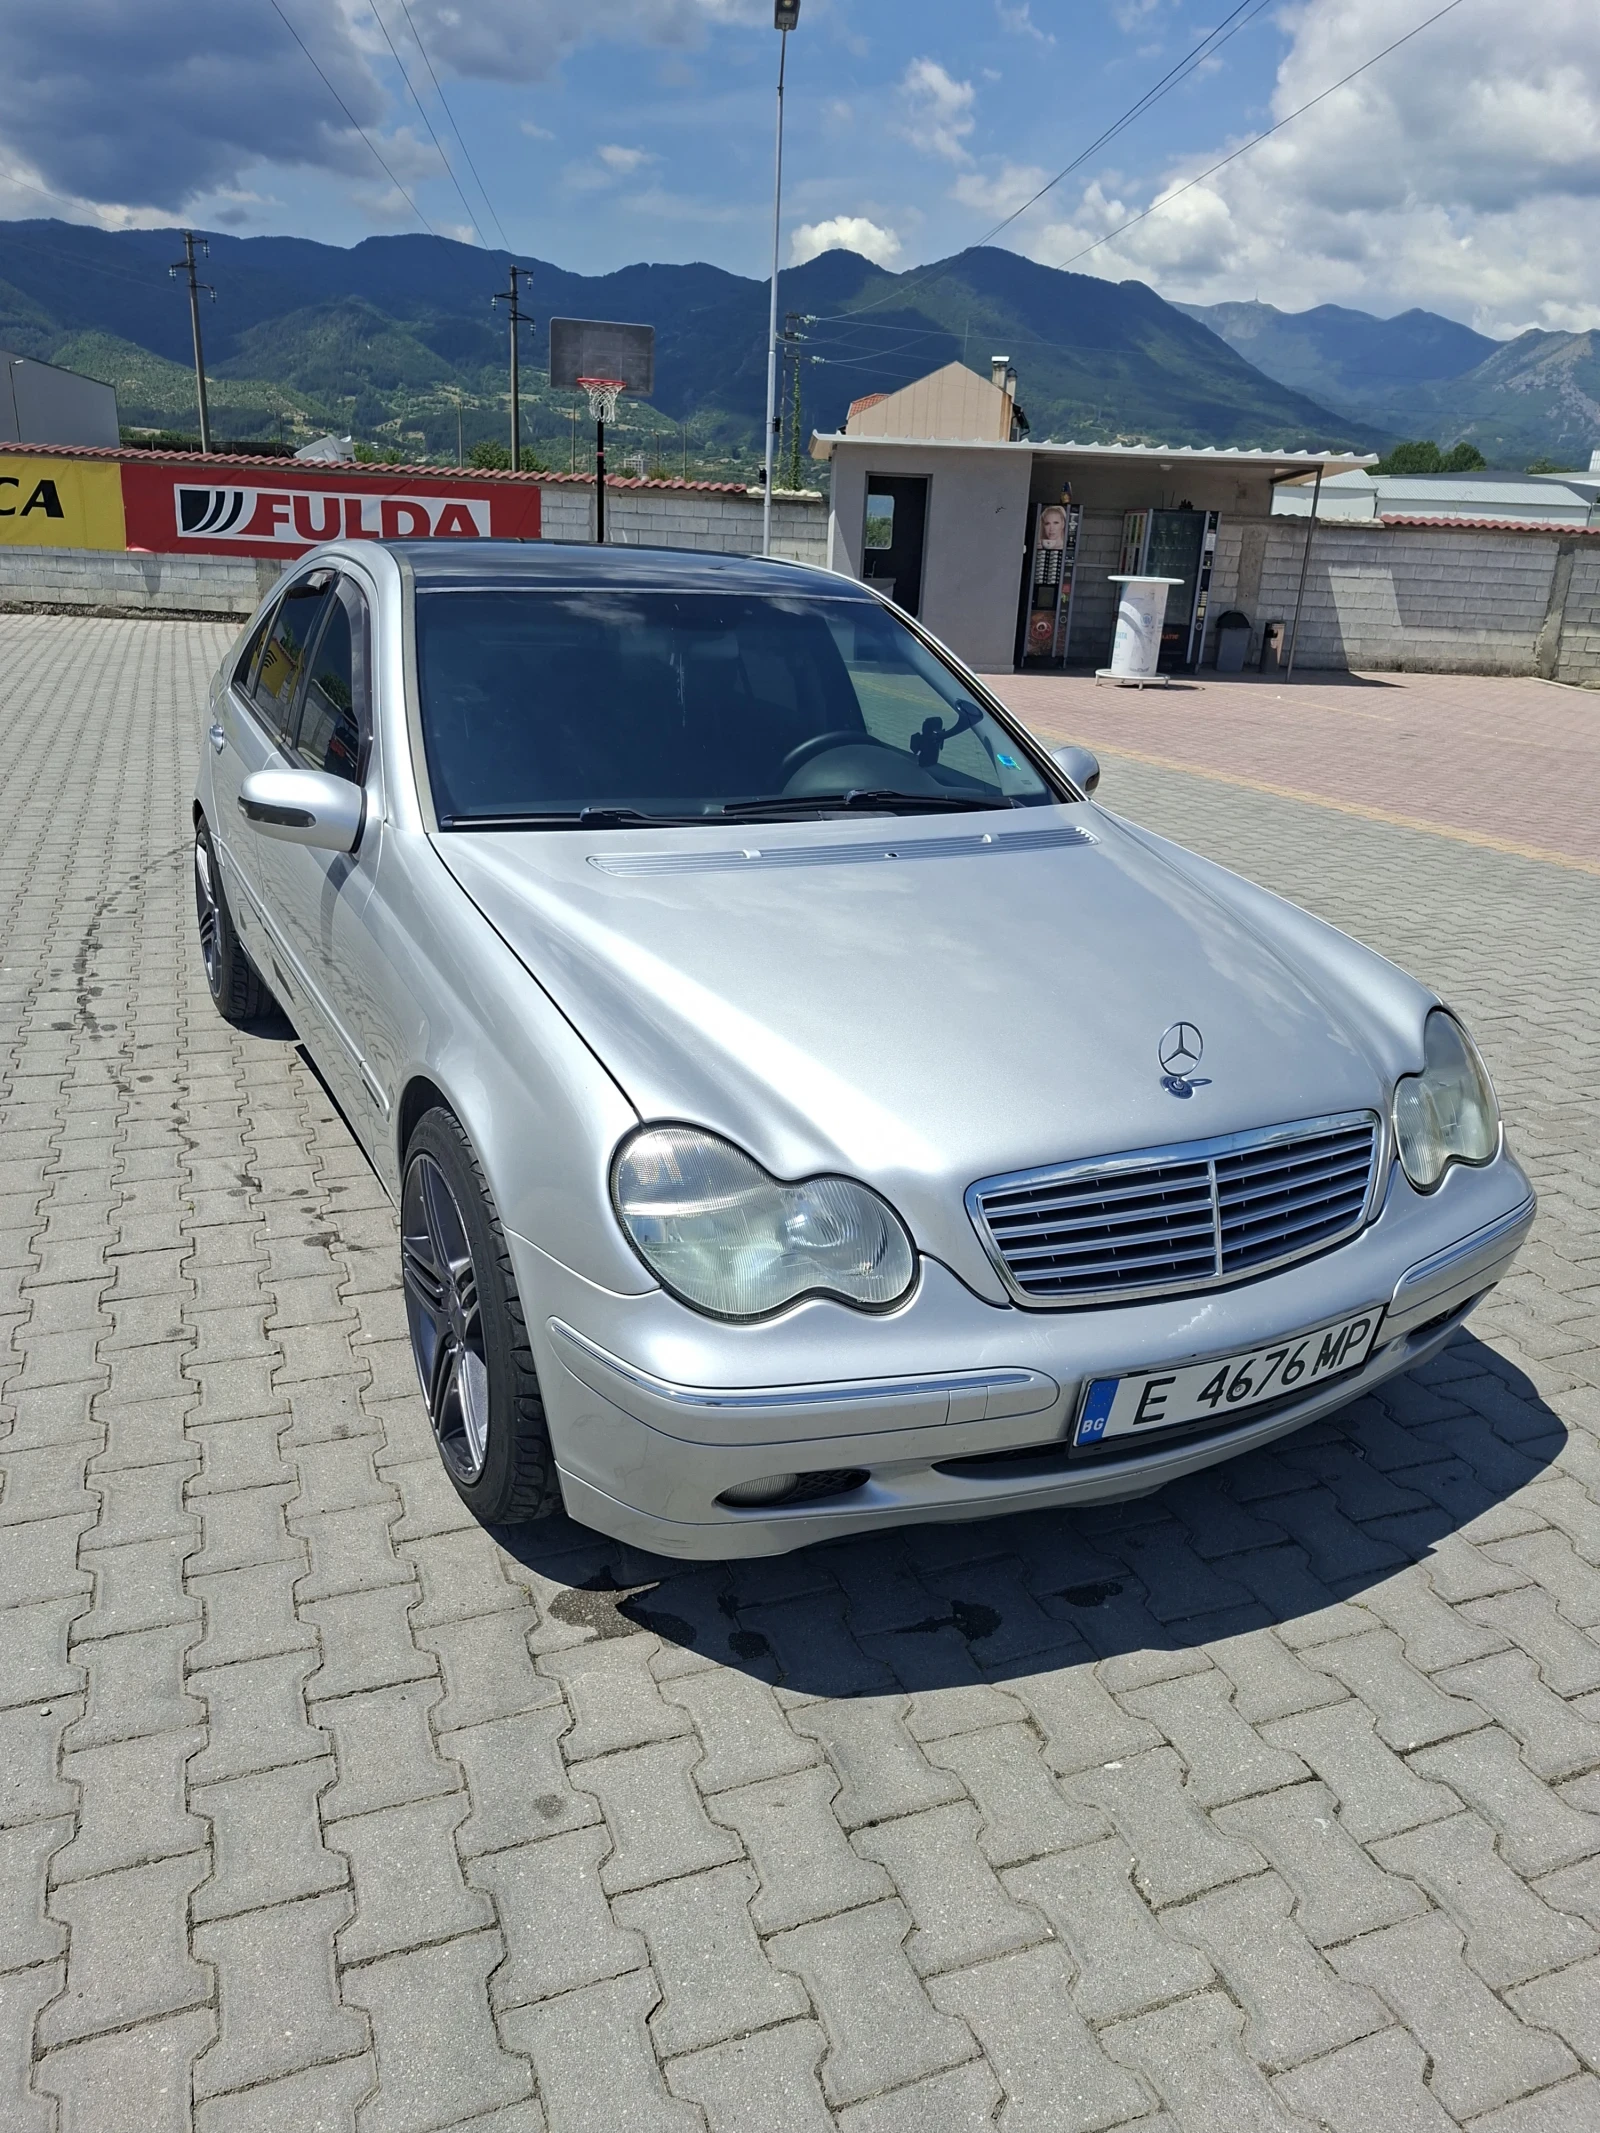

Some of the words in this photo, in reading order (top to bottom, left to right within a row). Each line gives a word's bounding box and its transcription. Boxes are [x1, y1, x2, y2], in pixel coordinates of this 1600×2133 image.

[234, 493, 480, 541] FULDA
[1133, 1376, 1176, 1425] E
[1197, 1341, 1310, 1408] 4676
[1311, 1319, 1371, 1376] MP
[1081, 1418, 1104, 1434] BG
